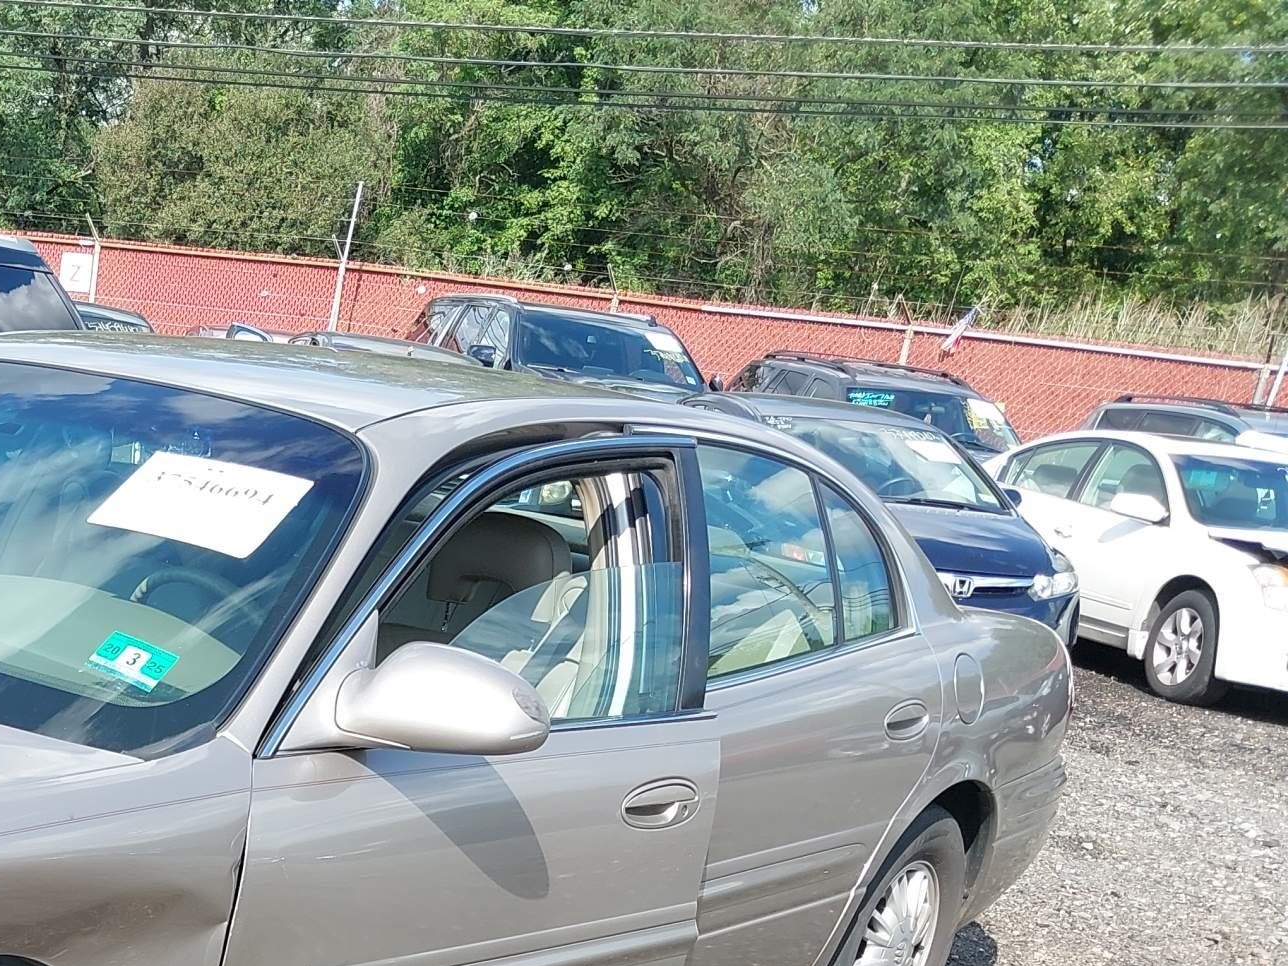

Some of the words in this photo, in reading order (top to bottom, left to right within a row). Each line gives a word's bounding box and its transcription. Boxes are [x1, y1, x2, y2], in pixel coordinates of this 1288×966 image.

[104, 643, 121, 655] 20
[126, 652, 141, 666] 3
[146, 661, 166, 674] 25
